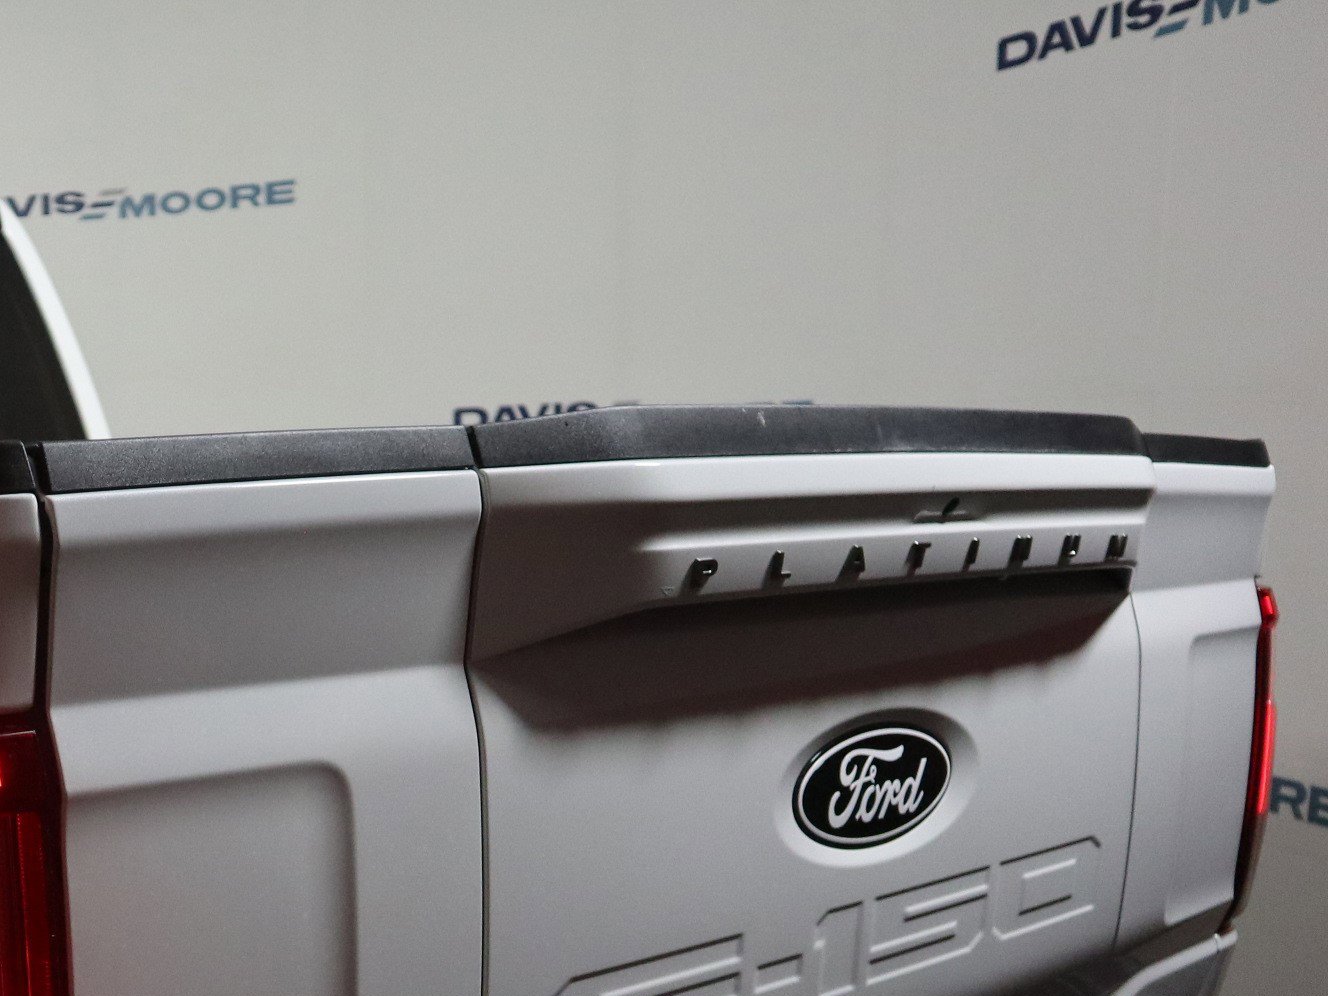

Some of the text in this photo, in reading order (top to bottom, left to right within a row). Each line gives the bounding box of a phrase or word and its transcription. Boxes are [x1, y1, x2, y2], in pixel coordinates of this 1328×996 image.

[118, 179, 296, 219] MOORE
[689, 533, 1128, 592] PLATINUM
[828, 744, 928, 829] Ford
